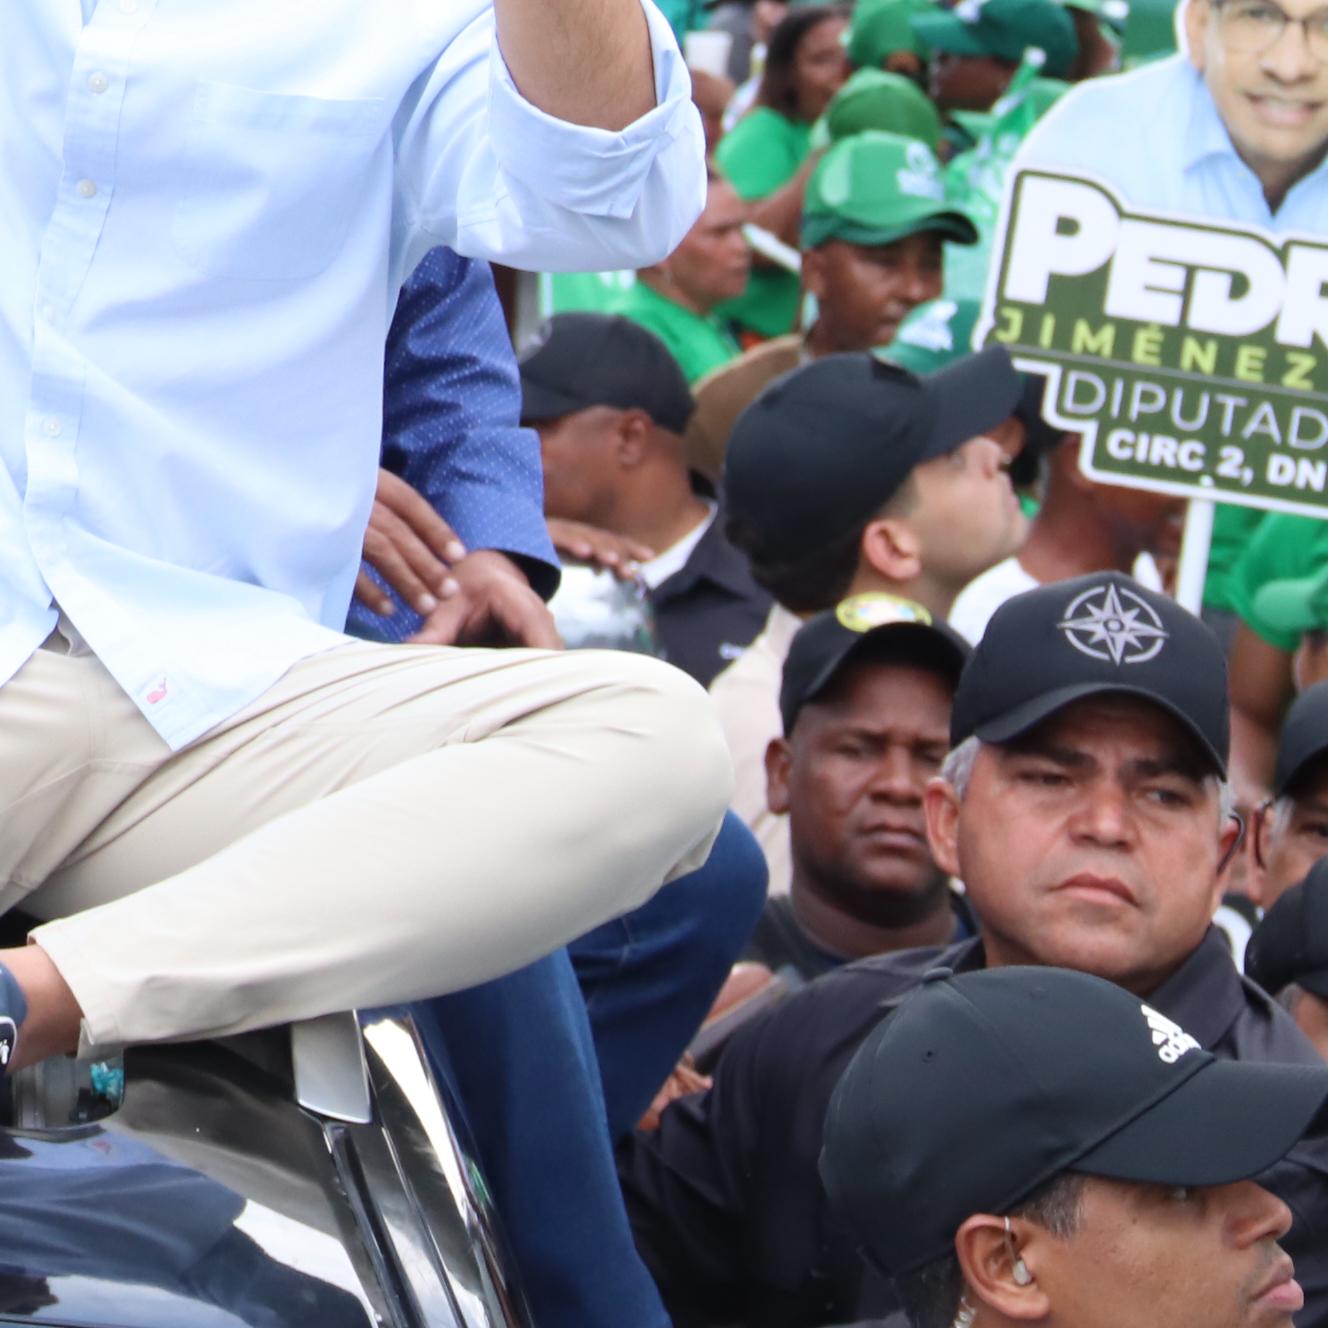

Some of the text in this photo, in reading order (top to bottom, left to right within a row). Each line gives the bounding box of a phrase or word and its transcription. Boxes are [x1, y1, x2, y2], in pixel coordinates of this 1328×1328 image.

[994, 307, 1318, 392] JIMÉNEZ
[1106, 429, 1328, 492] CIRC 2, DN
